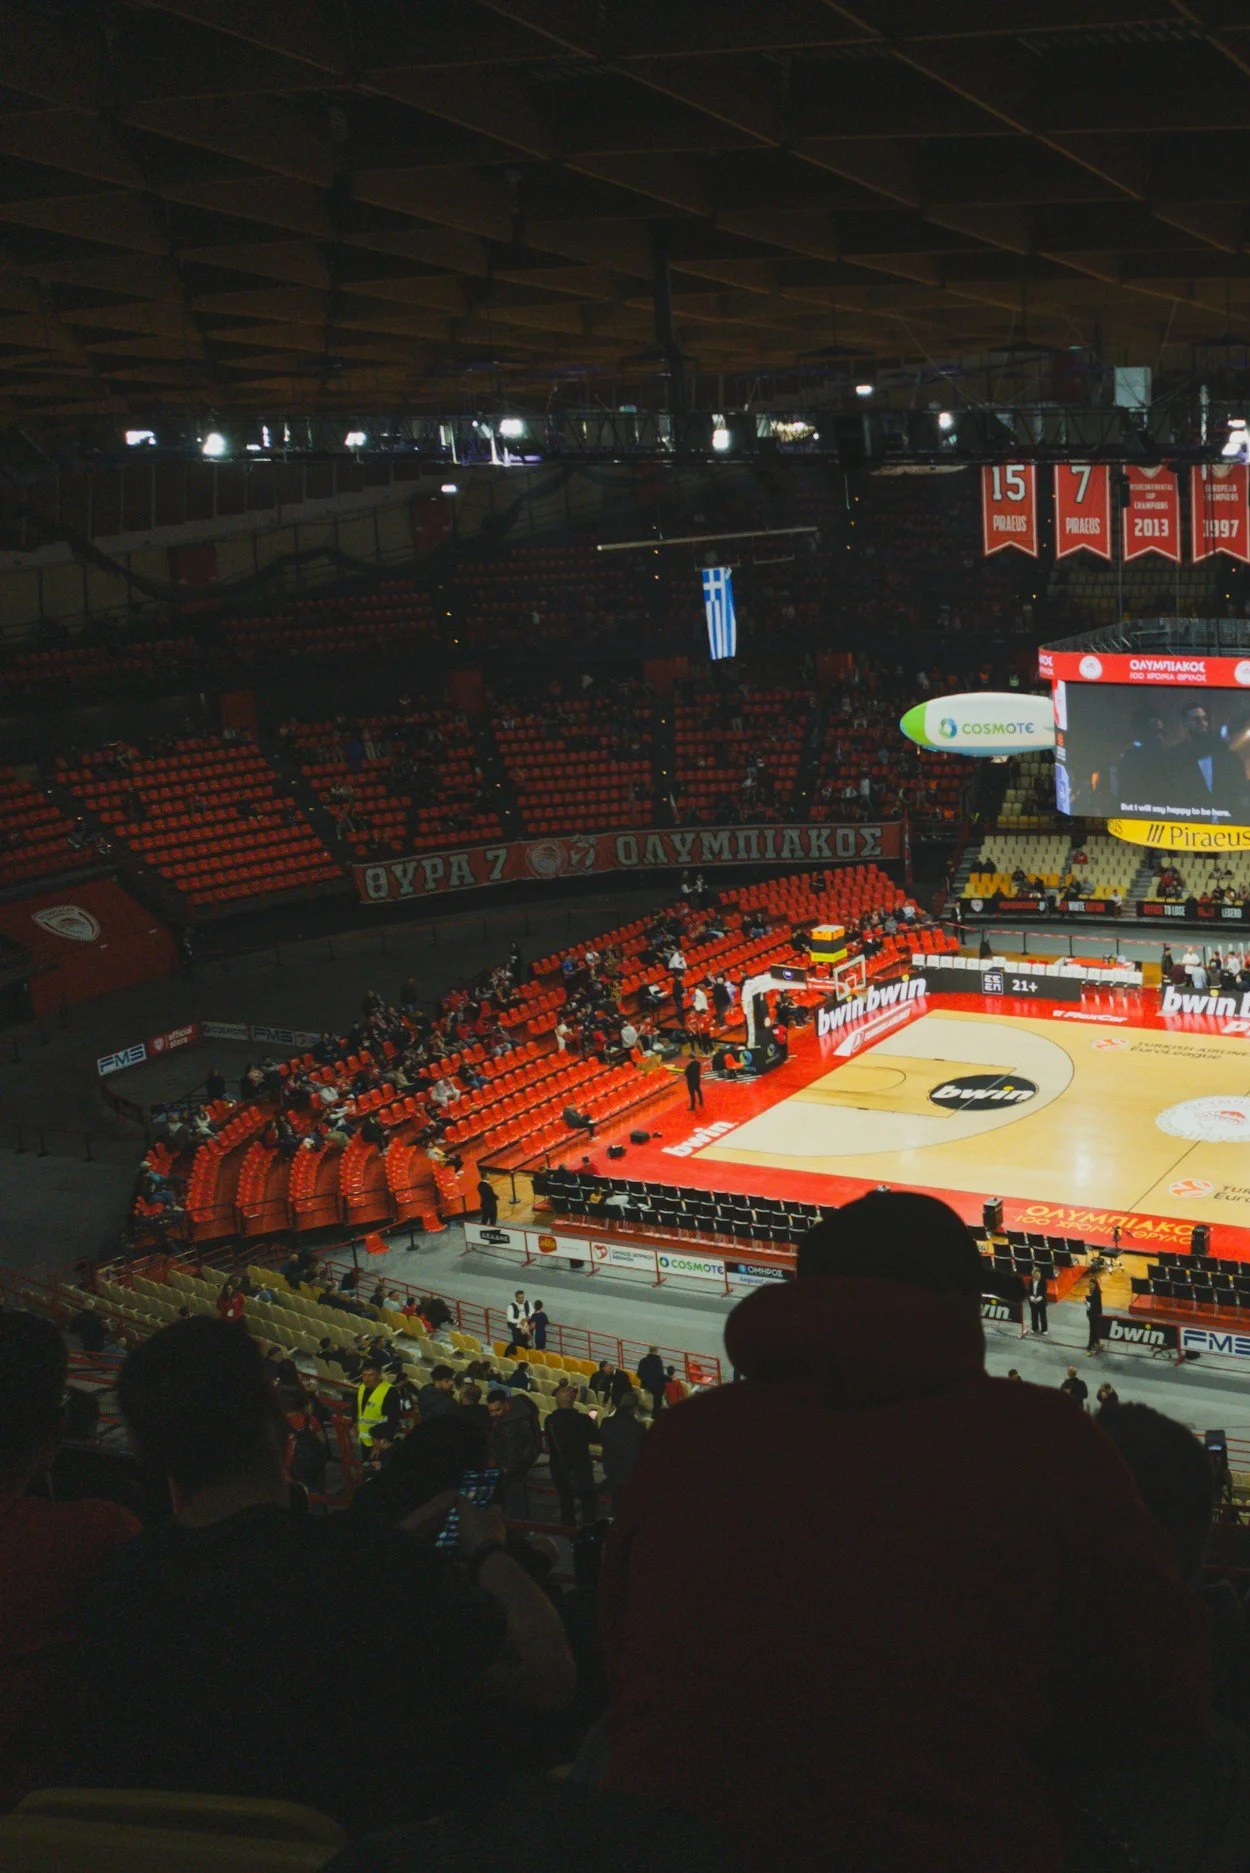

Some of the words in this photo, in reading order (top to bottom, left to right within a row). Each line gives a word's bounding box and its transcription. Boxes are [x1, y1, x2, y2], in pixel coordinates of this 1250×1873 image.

[991, 464, 1026, 501] 15
[1070, 464, 1092, 503] 7
[992, 514, 1027, 532] PIRAEUS
[1065, 516, 1101, 535] PIRAEUS
[1134, 518, 1170, 537] 2013
[1202, 519, 1240, 538] 1997
[1129, 659, 1206, 673] ΟΛΥΜΠΙΑΚΟΣ
[962, 722, 1034, 735] COSMOTE
[364, 853, 476, 899] ΘΥΡΑ
[485, 847, 508, 881] 7
[615, 827, 883, 867] ΟΛΥΜΠΙΑΚΟΣ
[1012, 979, 1038, 993] 21+
[99, 1044, 145, 1074] FMS
[930, 1084, 1036, 1103] bwin
[1026, 1204, 1194, 1237] ΟΛΥΜΠΙΑΚΟ
[1132, 1230, 1192, 1246] ΘΡΥΛΟ
[671, 1259, 724, 1275] COSMOTE
[747, 1265, 784, 1278] ΟΜΗΡΟΣ
[980, 1298, 1011, 1321] in
